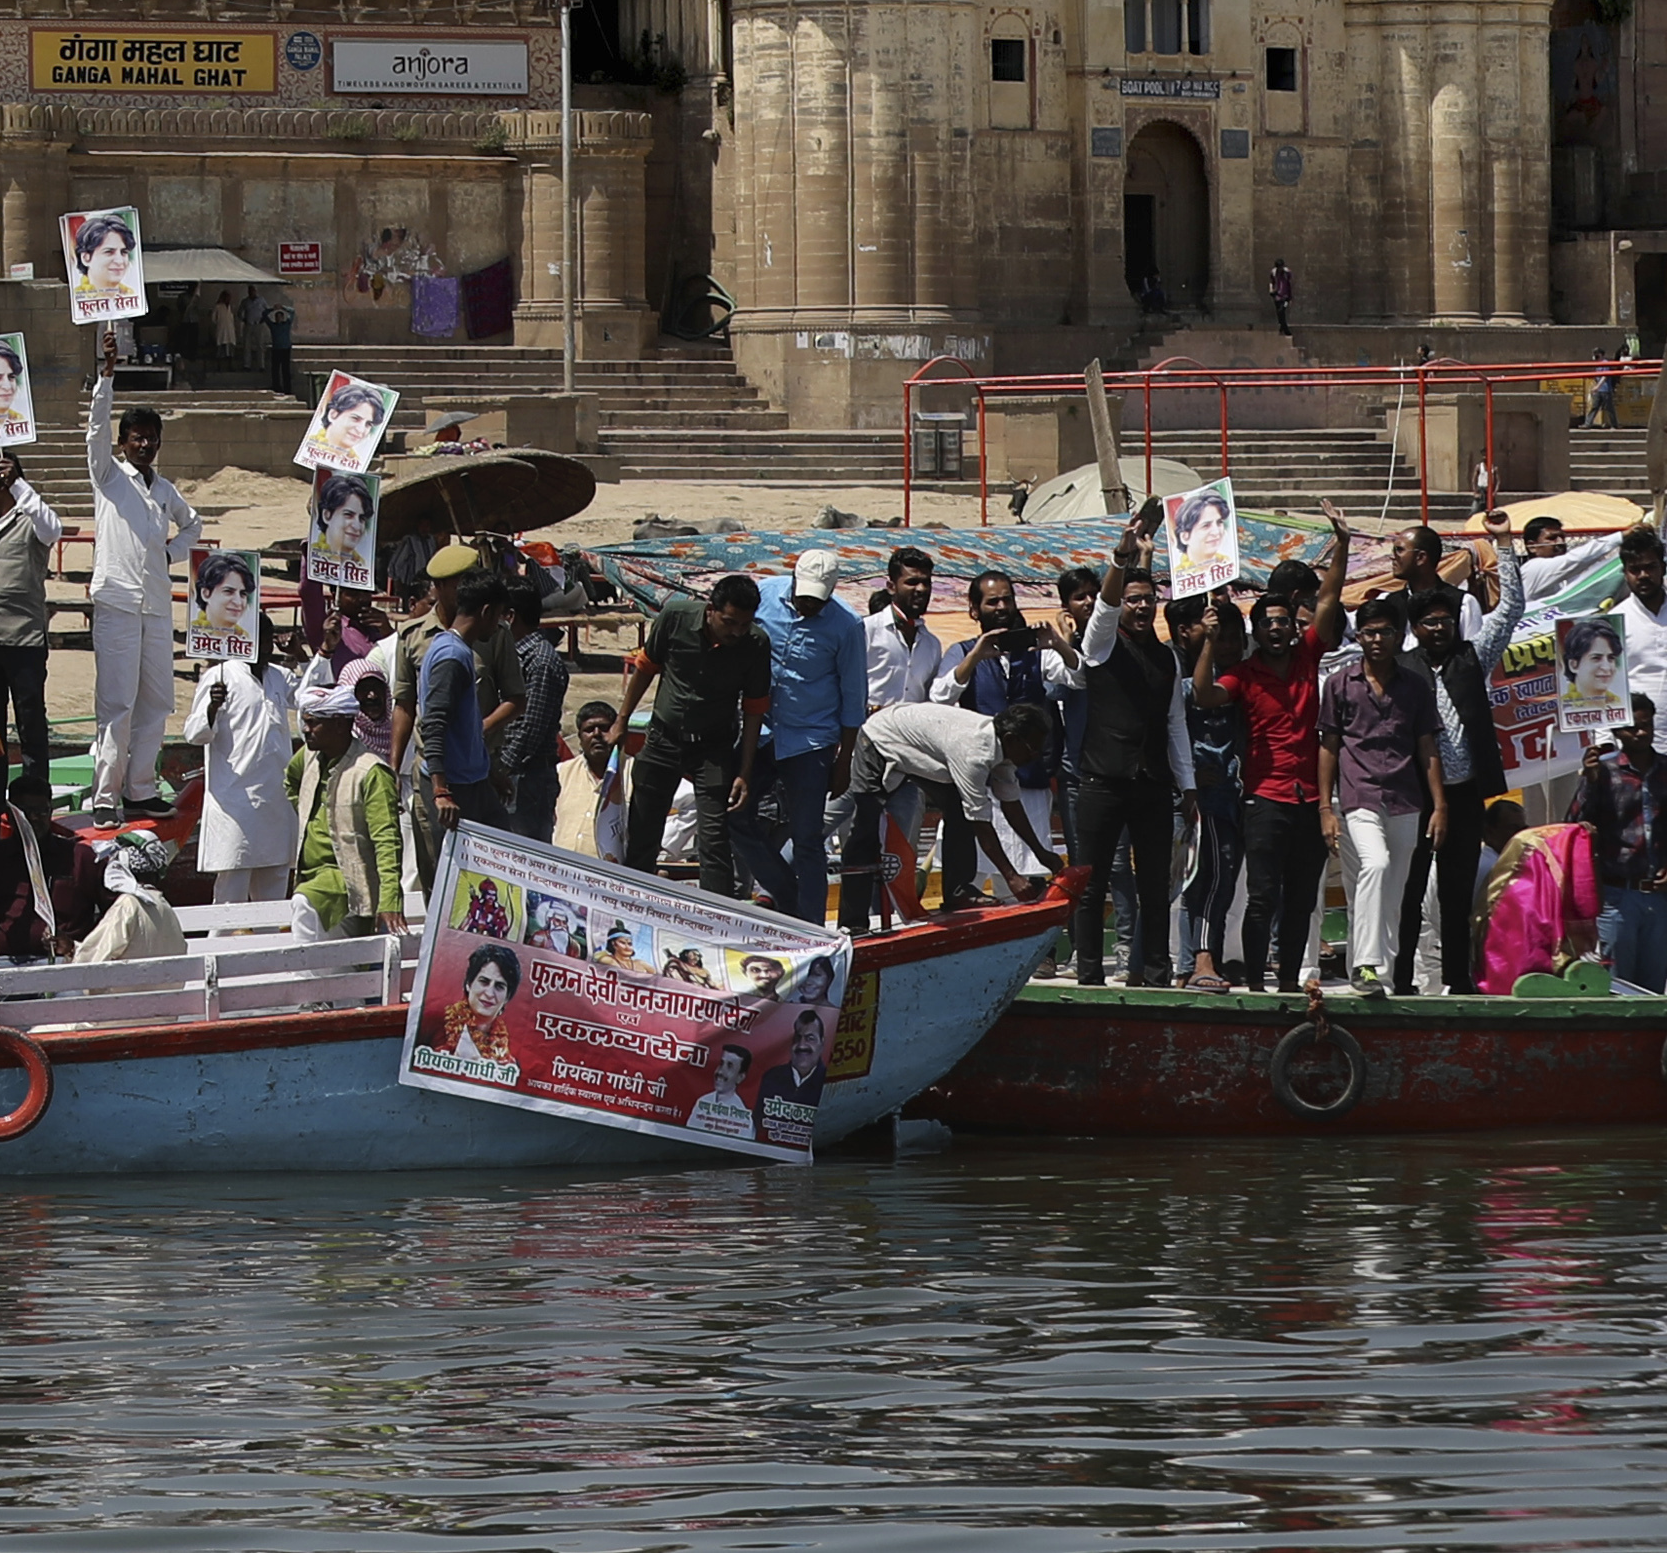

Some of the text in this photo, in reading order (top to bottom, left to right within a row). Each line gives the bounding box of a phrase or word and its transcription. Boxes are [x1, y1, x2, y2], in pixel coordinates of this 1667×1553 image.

[59, 34, 243, 65] गंगा महल घाट
[392, 47, 468, 80] anjora
[52, 66, 247, 86] GANGA MAHAL GHAT
[337, 80, 380, 88] TIMELESS
[382, 81, 436, 89] HANDWOVEN
[438, 81, 471, 89] SAREES
[482, 82, 523, 90] TEXTILES
[1122, 80, 1143, 93] BOAT
[77, 295, 140, 319] फूलन सेना
[4, 419, 30, 436] सेना
[306, 446, 336, 463] फूलन
[339, 454, 363, 471] देवी
[312, 557, 370, 584] उमेद सिंह
[1177, 563, 1235, 594] उमेद सिंह
[193, 633, 253, 657] उमेद सिंह
[1605, 705, 1626, 722] सेना
[490, 846, 510, 862] फूलन
[511, 851, 527, 867] देवी
[509, 863, 526, 880] सेना
[531, 959, 761, 1034] फूलन देवी जनजागरण सेना
[616, 1011, 641, 1027] एवं
[536, 1011, 710, 1069] एकलव्य सेना
[415, 1046, 520, 1087] प्रियंका गांधी जी
[552, 1055, 668, 1099] प्रियंका गांधी जी
[527, 1078, 552, 1092] आपका
[553, 1082, 577, 1097] हार्दिक
[577, 1088, 603, 1102] स्वागत
[764, 1095, 791, 1119] उमेद
